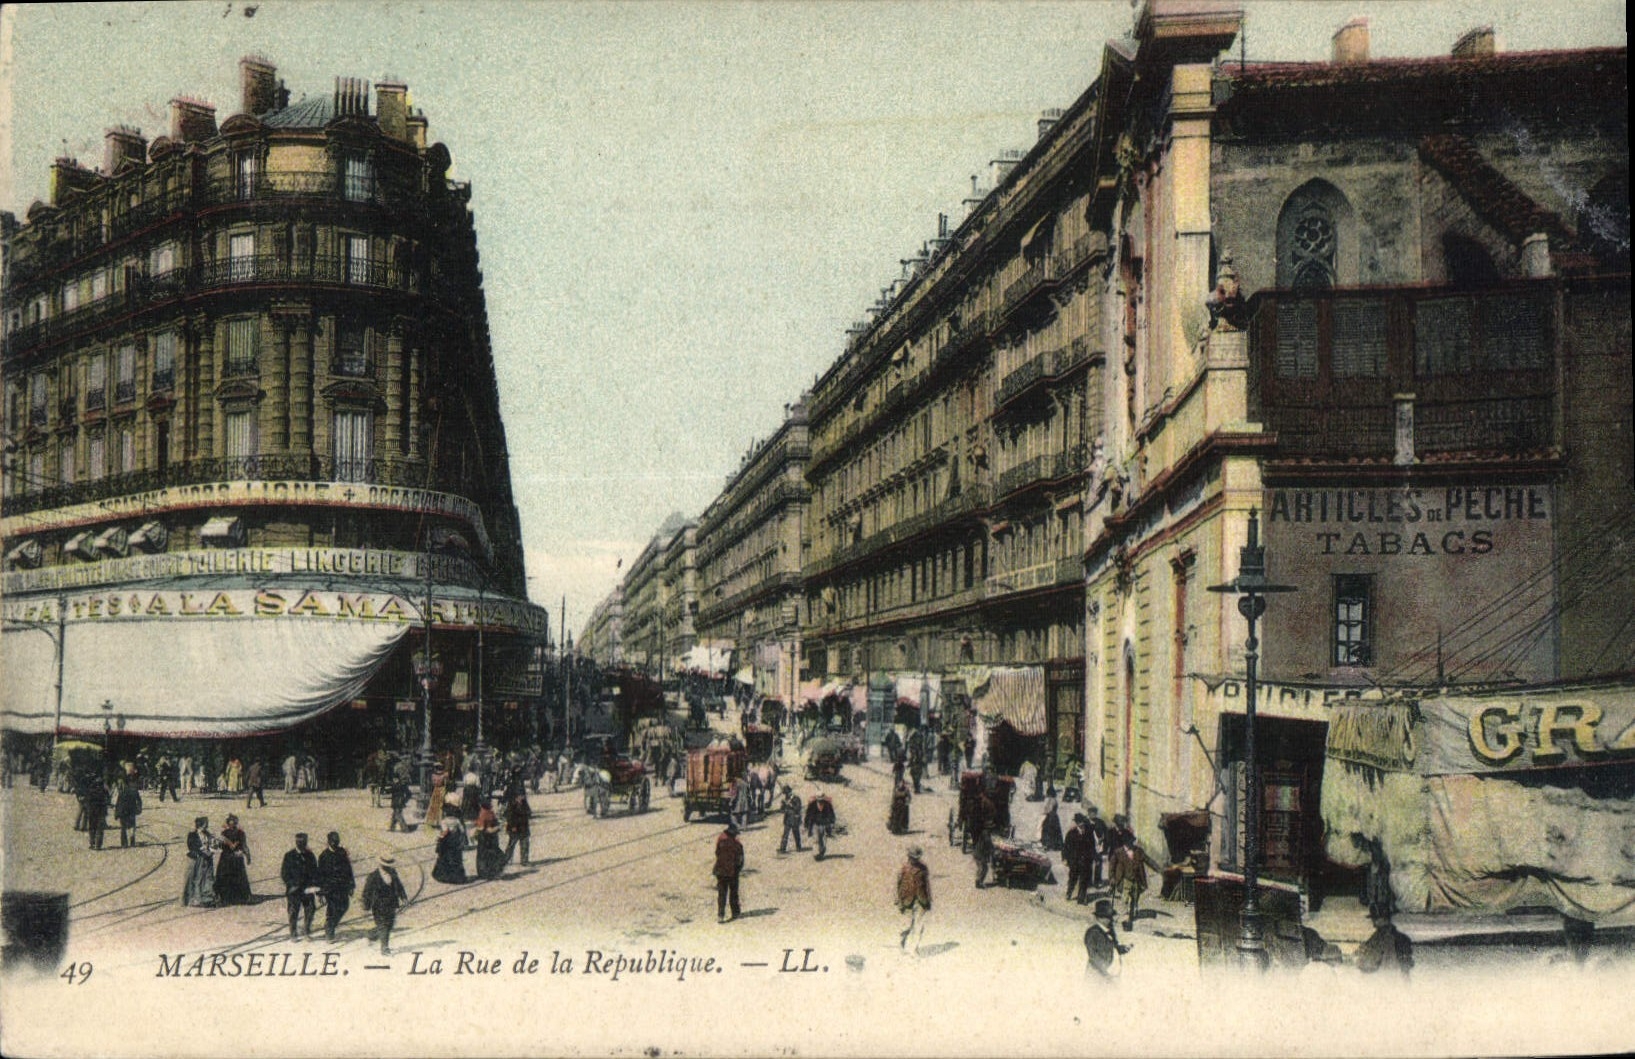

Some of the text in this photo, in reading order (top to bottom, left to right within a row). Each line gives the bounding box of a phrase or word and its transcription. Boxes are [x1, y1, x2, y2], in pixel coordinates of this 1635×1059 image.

[1269, 488, 1423, 523] ARTICLES
[1426, 508, 1443, 522] DE
[1316, 530, 1495, 556] TABACS
[290, 549, 402, 576] LINGERIE
